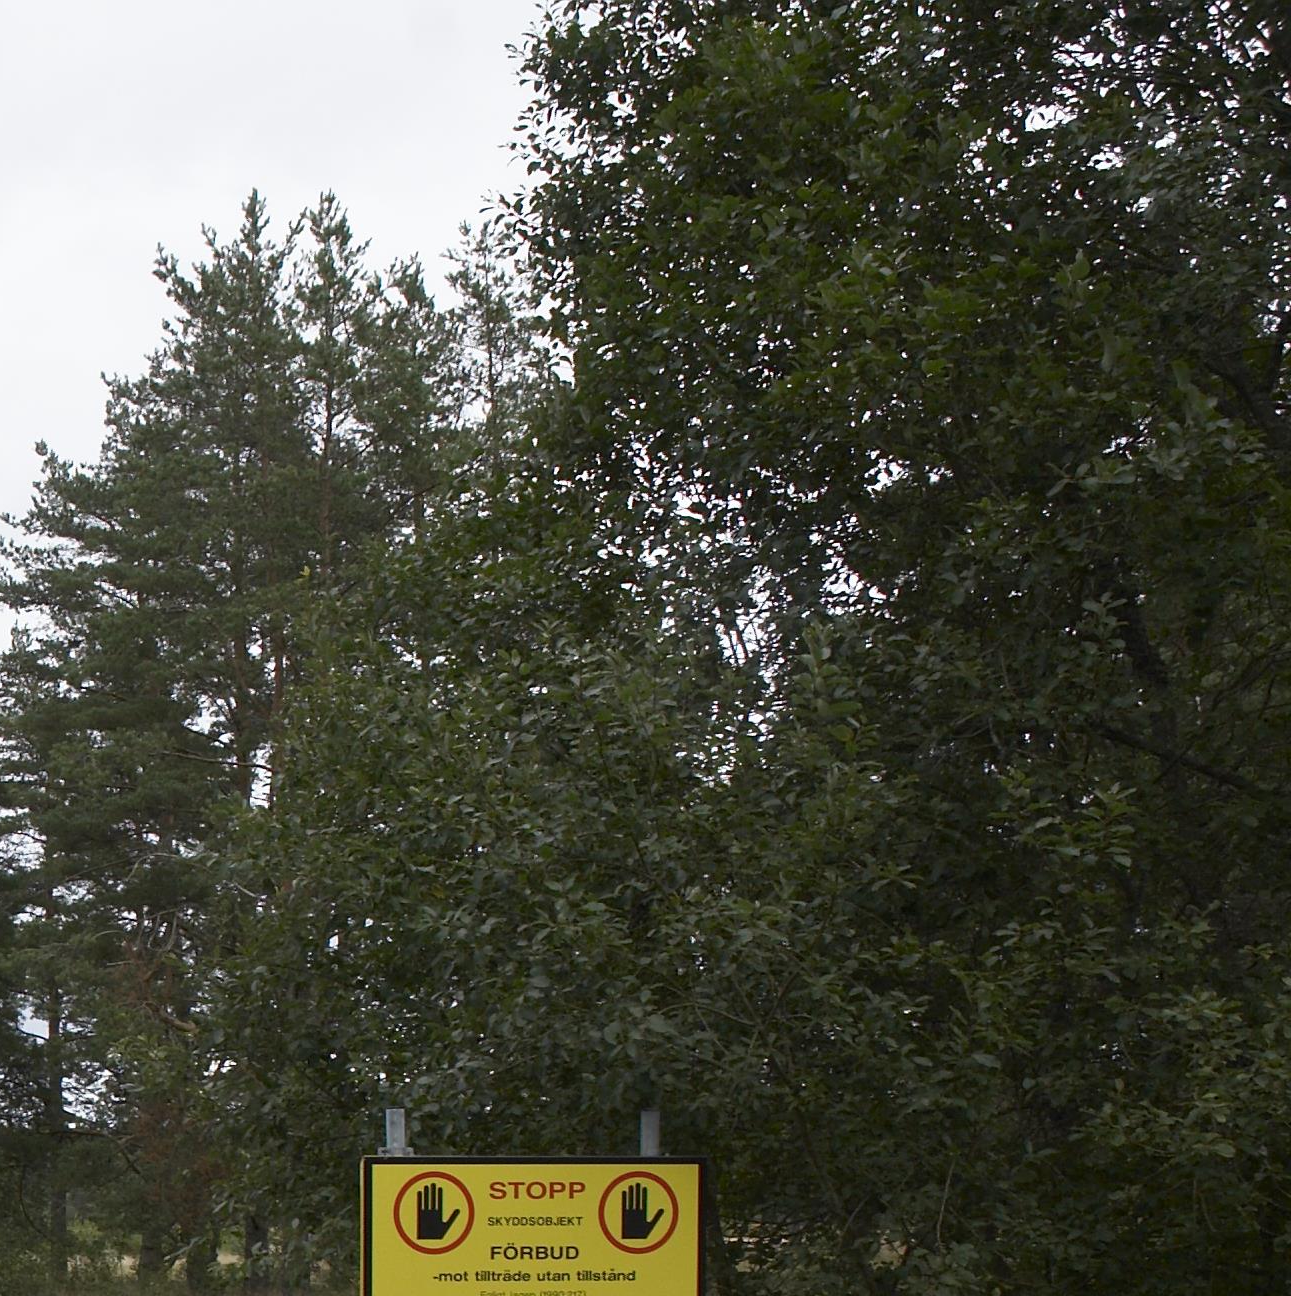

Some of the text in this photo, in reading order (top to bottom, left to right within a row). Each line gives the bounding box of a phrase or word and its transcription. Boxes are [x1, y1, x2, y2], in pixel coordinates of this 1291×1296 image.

[488, 1181, 586, 1200] STOPP
[487, 1216, 583, 1227] SKYDDSOBJEKT
[490, 1243, 579, 1260] FÖRBUD
[475, 1270, 531, 1282] tillträde
[537, 1271, 569, 1282] utan
[577, 1268, 636, 1282] tillstånd
